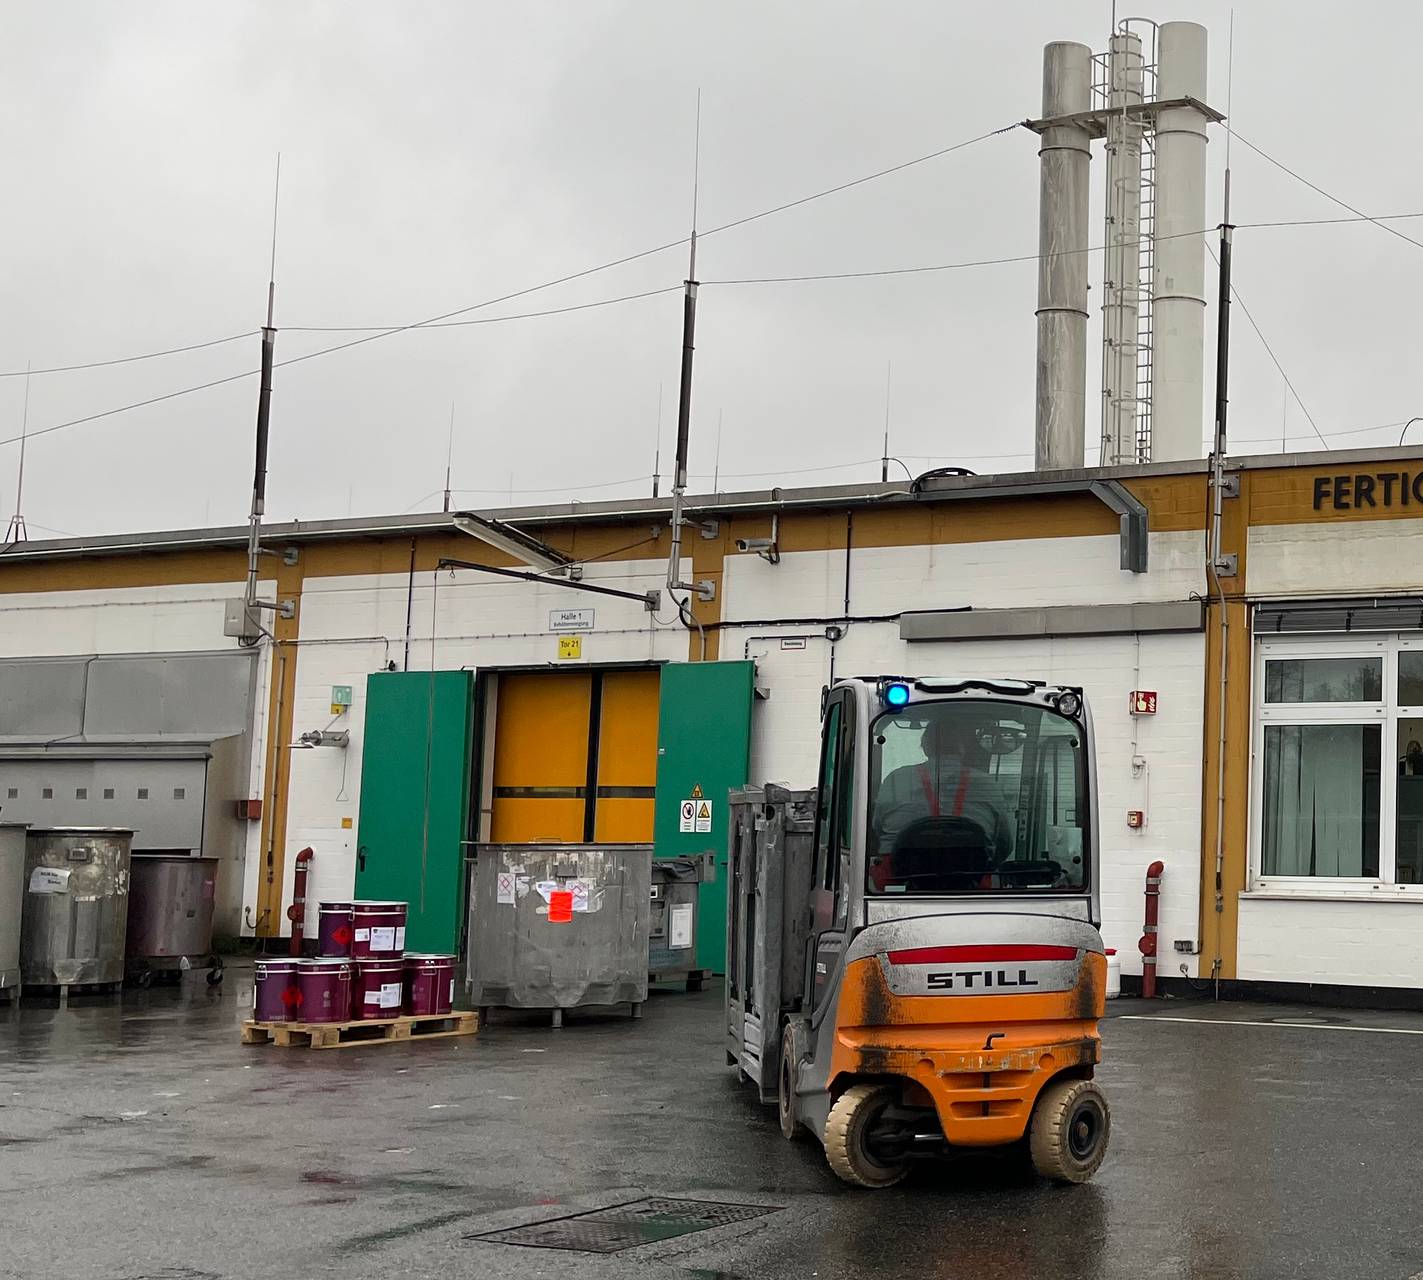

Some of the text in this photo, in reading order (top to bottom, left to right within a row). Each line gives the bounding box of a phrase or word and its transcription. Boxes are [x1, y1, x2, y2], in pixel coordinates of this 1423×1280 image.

[560, 612, 577, 620] Halle
[560, 640, 579, 648] Tor 21
[927, 969, 1039, 990] STILL
